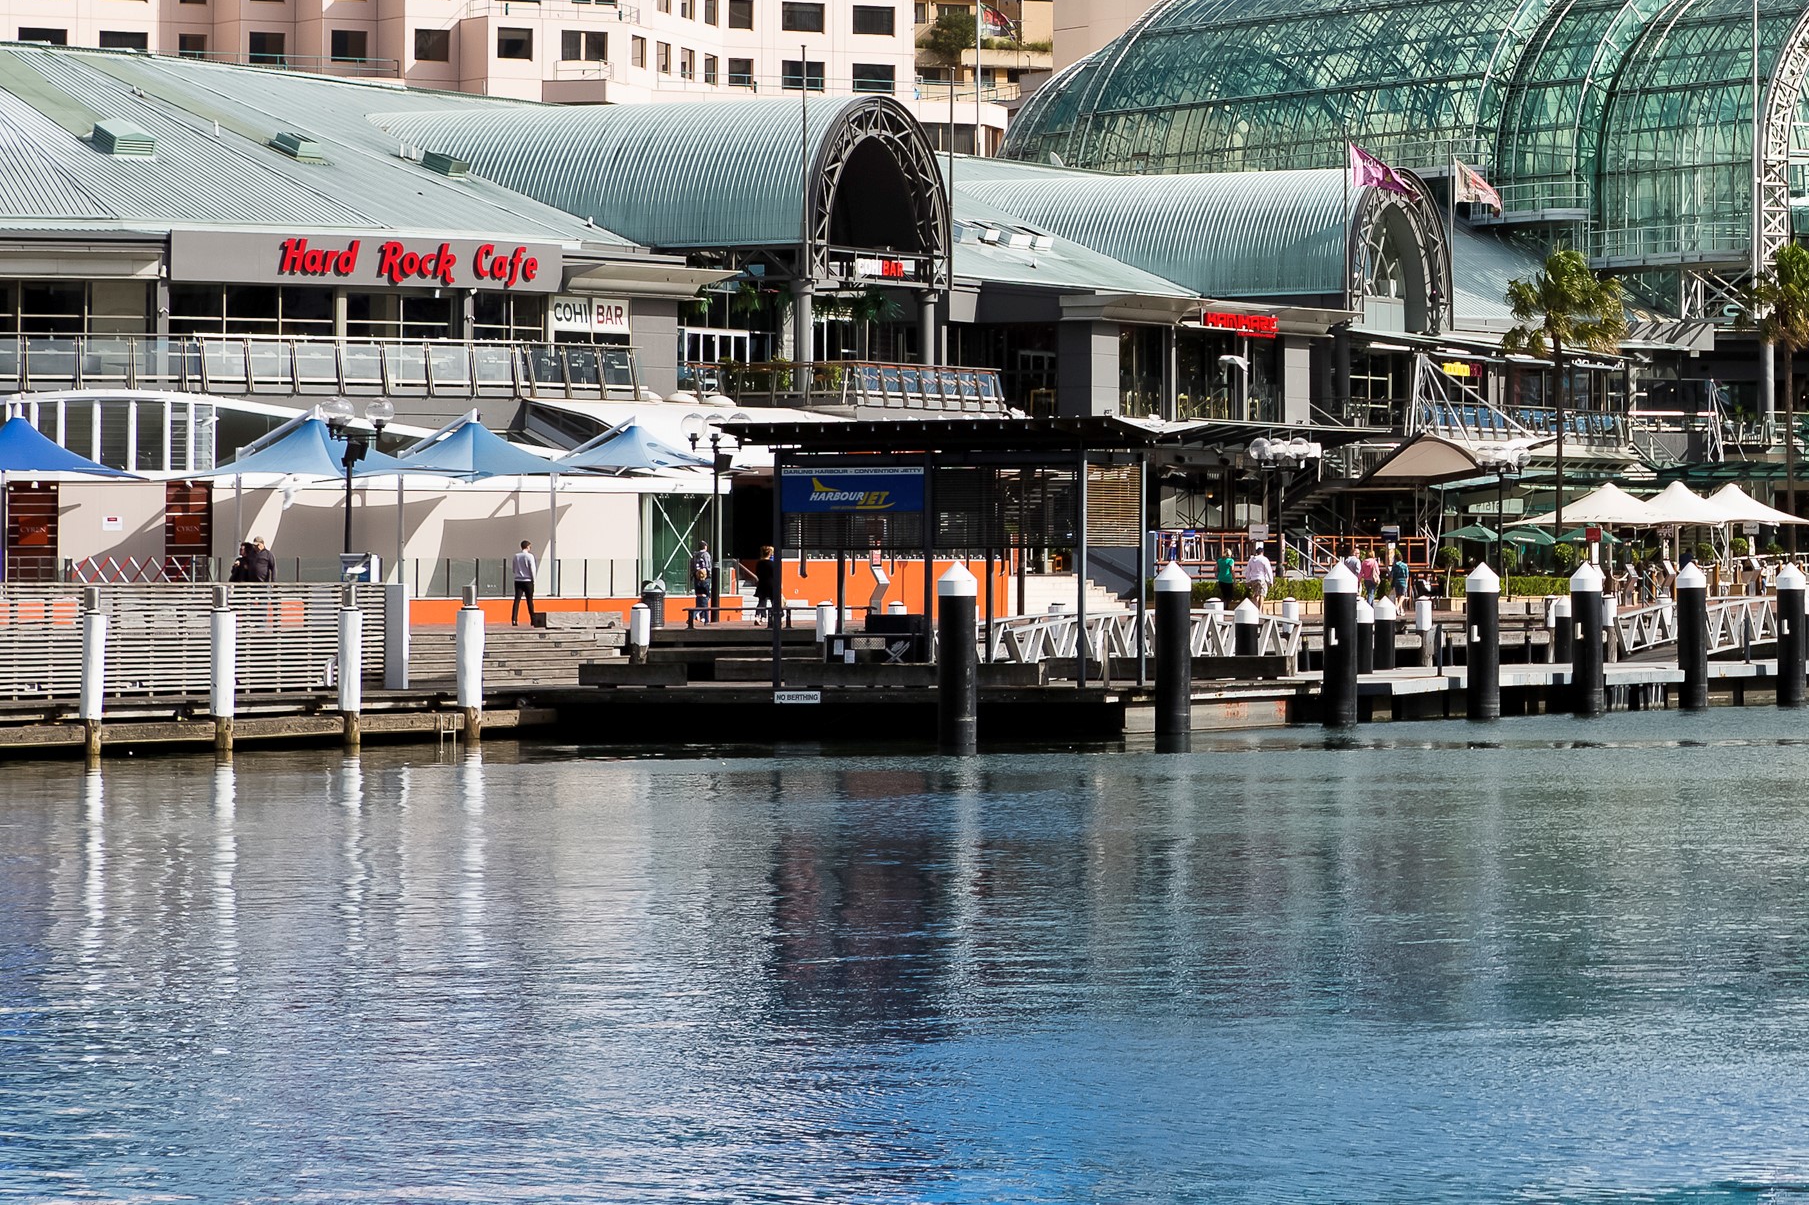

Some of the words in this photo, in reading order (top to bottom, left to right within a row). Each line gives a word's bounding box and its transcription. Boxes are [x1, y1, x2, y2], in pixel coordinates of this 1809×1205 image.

[280, 238, 361, 276] Hard
[378, 241, 457, 285] Rock
[474, 244, 539, 288] Cafe
